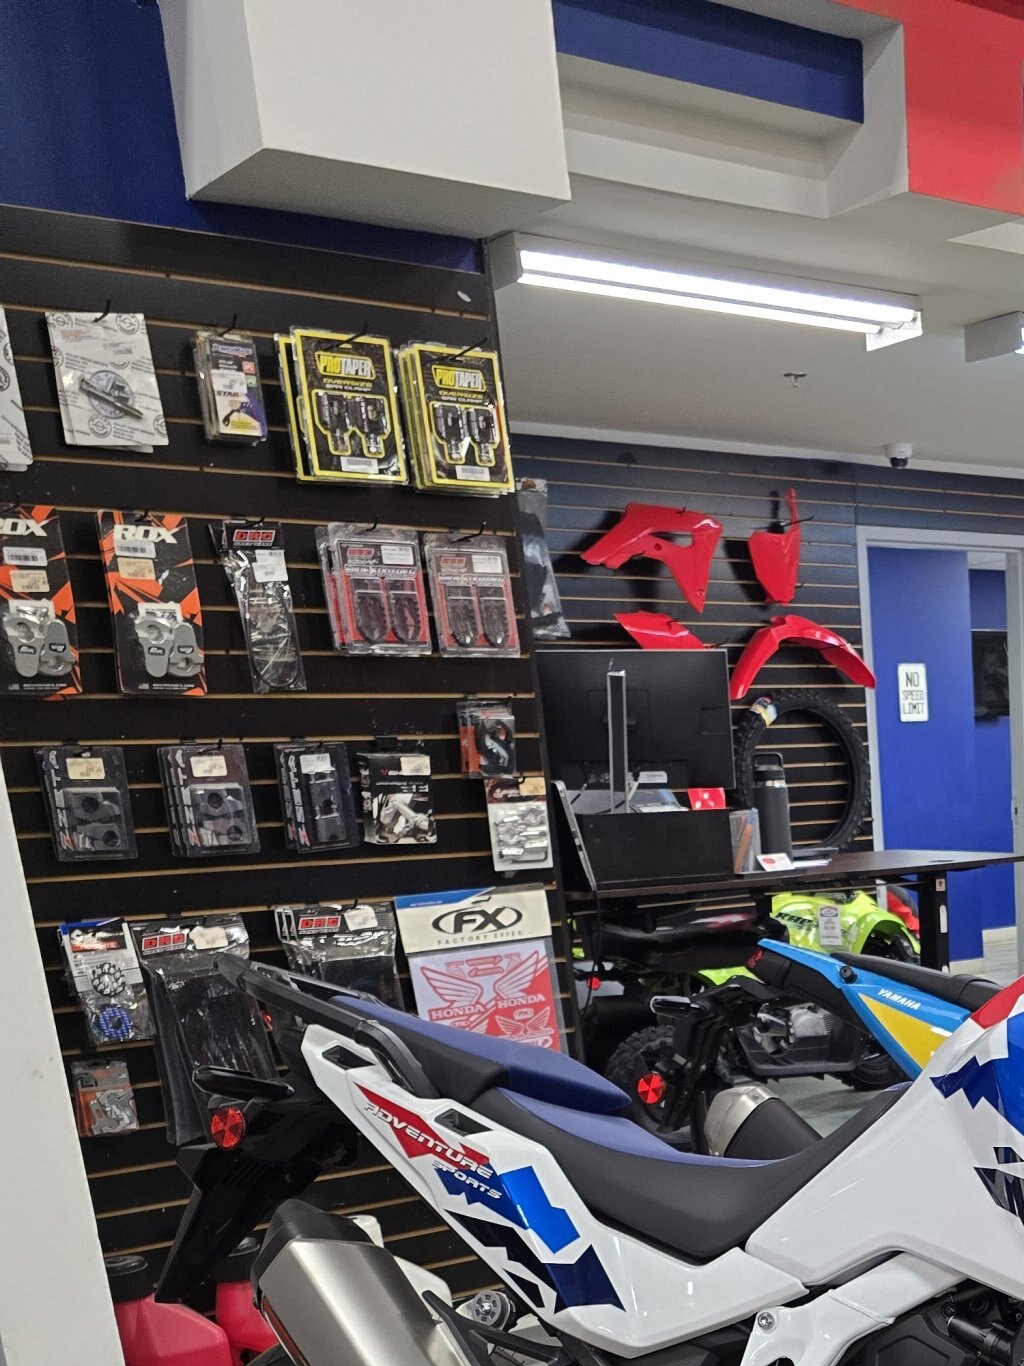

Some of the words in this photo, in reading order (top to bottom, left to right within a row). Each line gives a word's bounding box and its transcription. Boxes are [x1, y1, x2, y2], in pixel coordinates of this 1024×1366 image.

[905, 671, 920, 687] NO
[902, 690, 924, 700] SPEED
[903, 702, 924, 714] LIMIT
[453, 907, 507, 934] FX
[437, 934, 488, 945] FACTORY
[498, 994, 546, 1009] HONDA
[878, 989, 921, 1010] YAMAHA
[431, 1004, 485, 1020] HONDA
[364, 1102, 494, 1180] ADVENTURE
[431, 1159, 503, 1200] SPORTS
